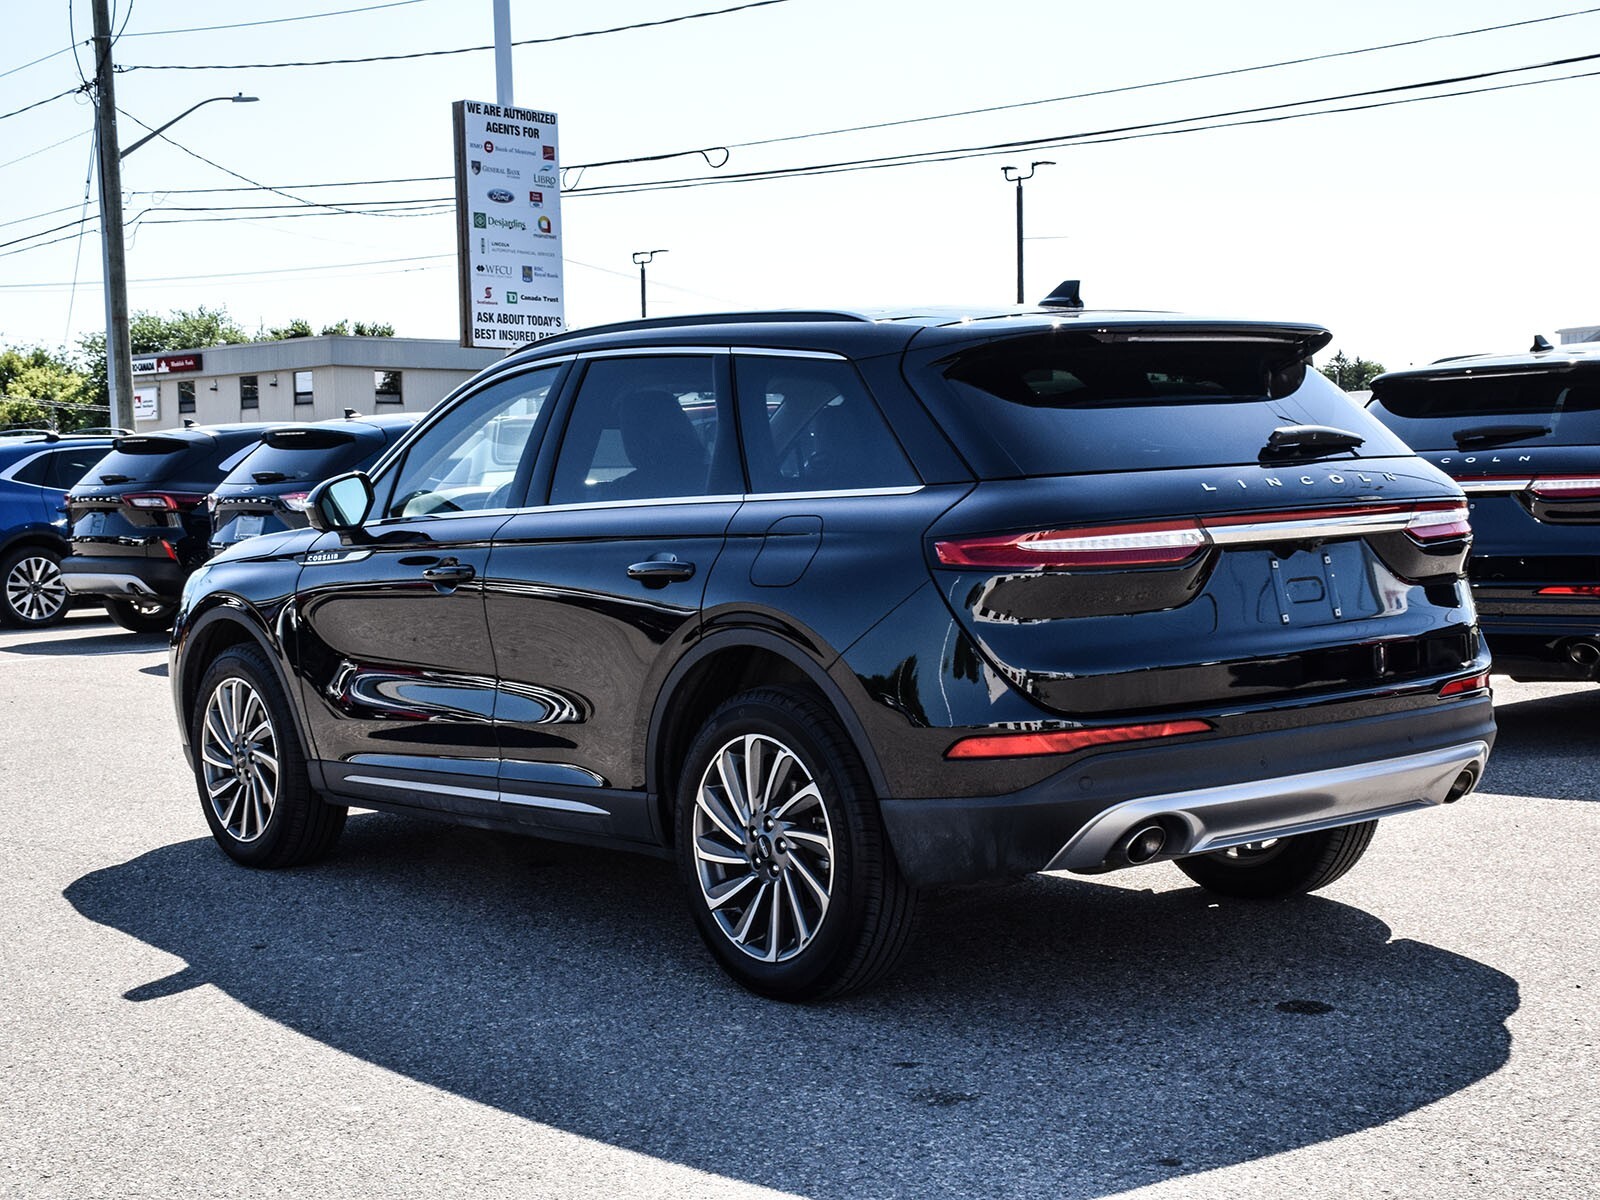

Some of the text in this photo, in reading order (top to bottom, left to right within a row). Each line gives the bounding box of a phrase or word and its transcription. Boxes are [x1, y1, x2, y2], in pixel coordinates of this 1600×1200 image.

[466, 102, 556, 125] WE ARE AUTHORIZED
[486, 122, 540, 139] AGENTS FOR
[533, 173, 556, 185] LIBRO
[491, 191, 511, 201] Ford
[487, 216, 526, 230] Desjardins
[486, 264, 513, 275] WFCU
[520, 293, 542, 302] Canada
[543, 295, 559, 303] Trust
[476, 312, 562, 328] ASK ABOUT TODAY'S
[474, 328, 496, 340] BEST
[498, 329, 537, 342] INSURED
[1201, 472, 1397, 492] LINCOLN
[307, 553, 339, 562] CORSAIR
